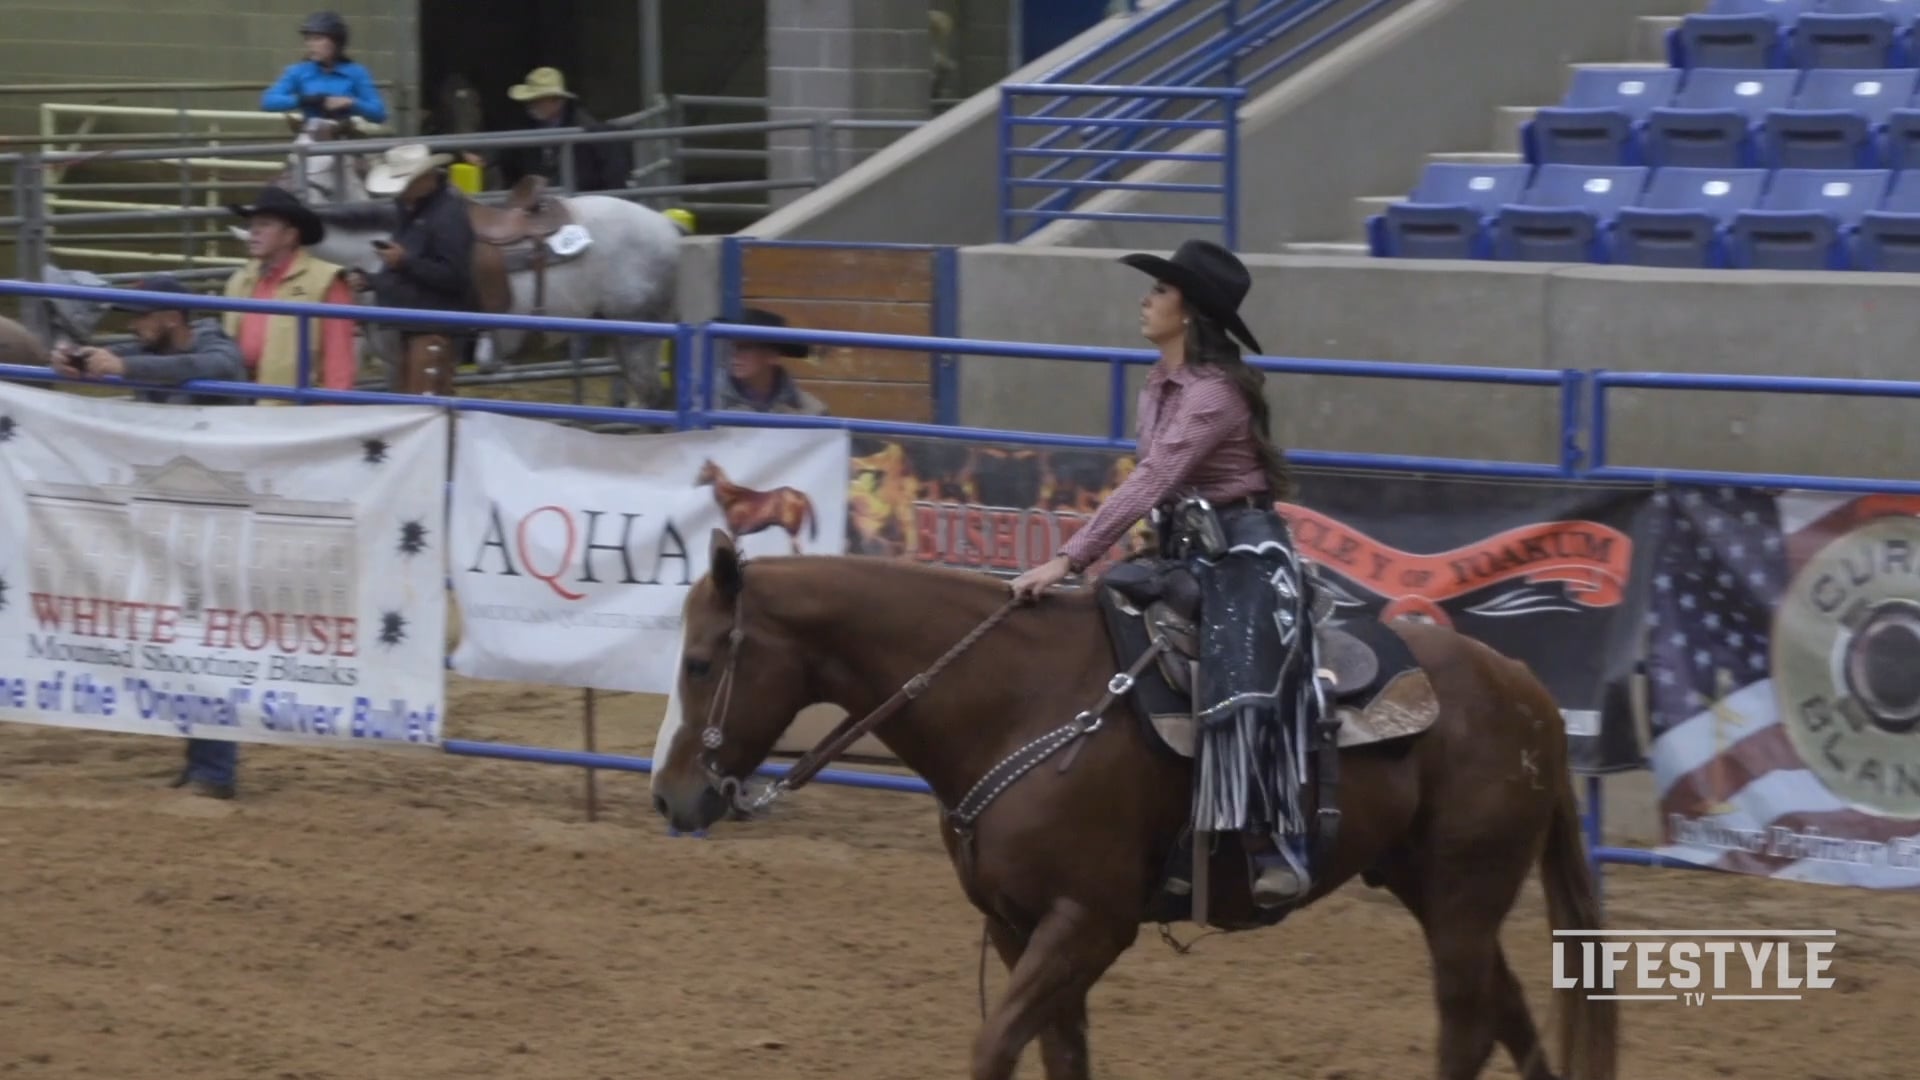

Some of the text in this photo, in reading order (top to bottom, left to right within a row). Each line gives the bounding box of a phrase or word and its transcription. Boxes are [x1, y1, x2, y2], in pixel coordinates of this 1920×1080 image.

[467, 501, 692, 600] AQHA
[1449, 531, 1614, 584] YOAKUM
[1811, 538, 1920, 613] CUR
[29, 592, 358, 657] WHITE HOUSE
[27, 633, 358, 686] Mounted Shooting Blanks
[37, 670, 65, 711] of
[72, 673, 116, 715] the
[123, 677, 251, 734] "Original"
[260, 690, 344, 735] Silver
[353, 697, 437, 742] Bullet
